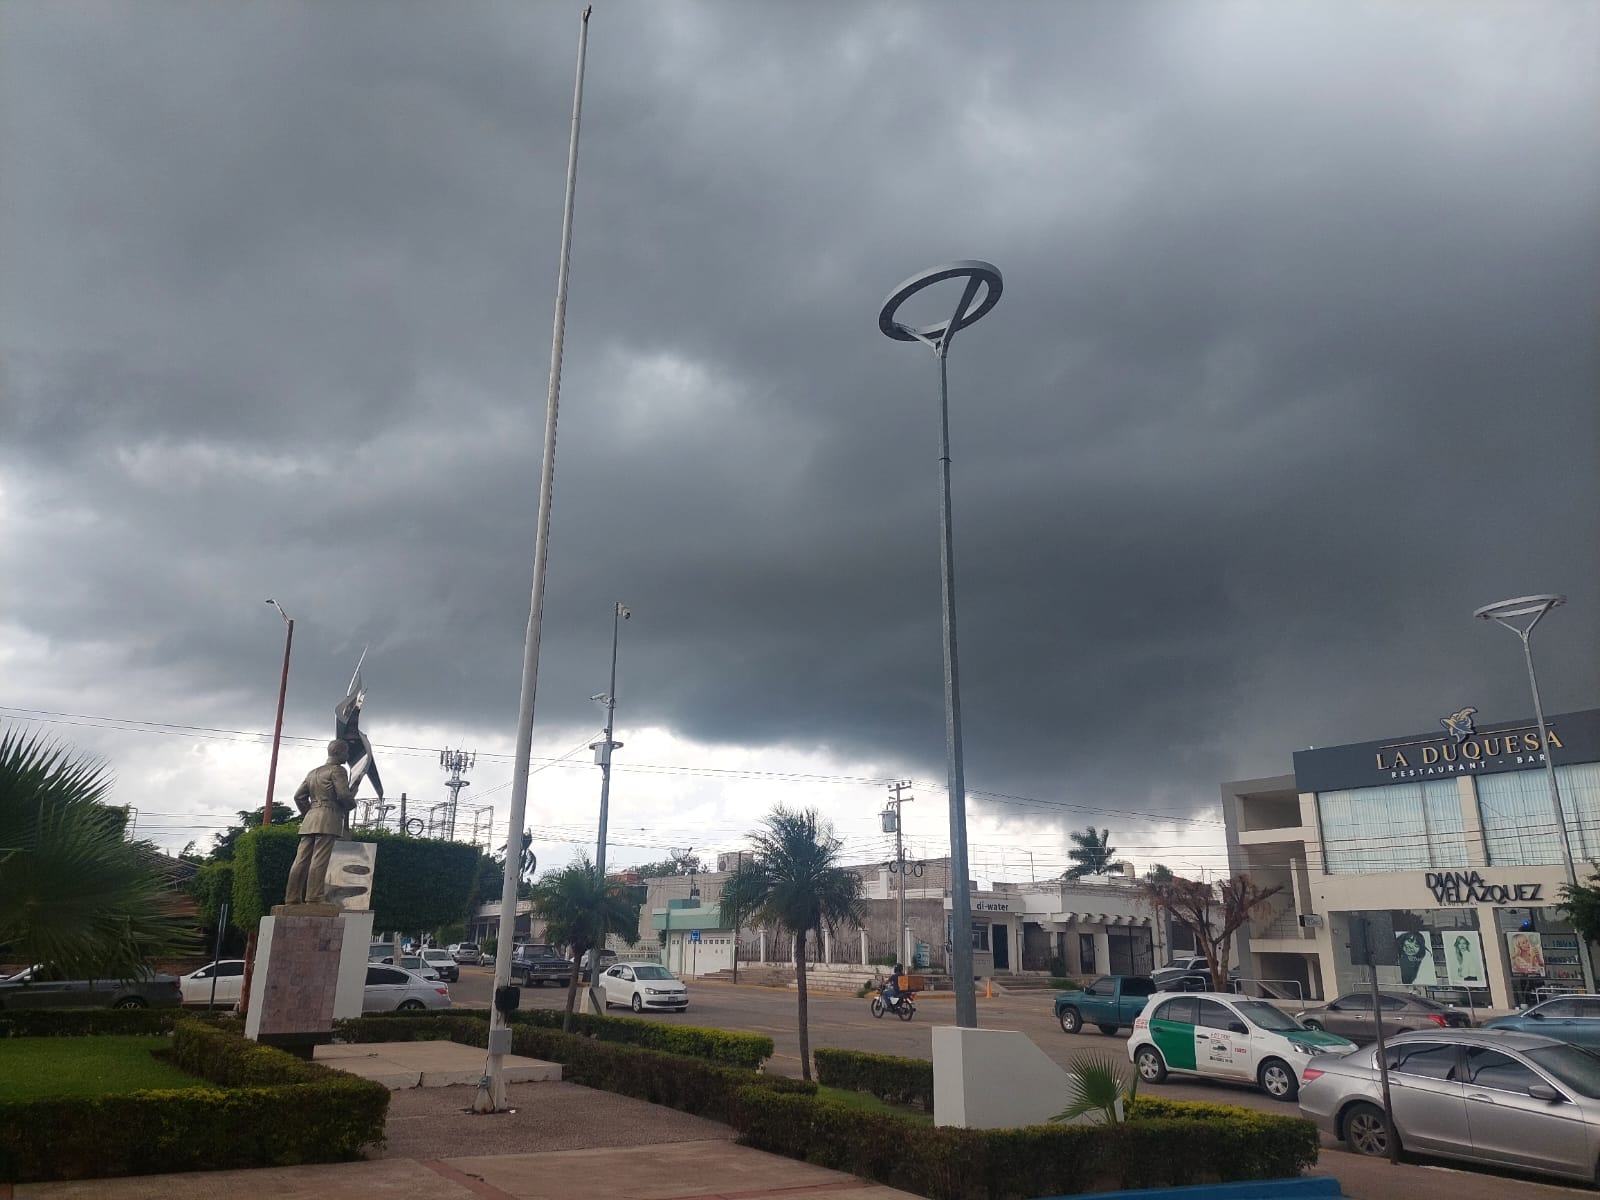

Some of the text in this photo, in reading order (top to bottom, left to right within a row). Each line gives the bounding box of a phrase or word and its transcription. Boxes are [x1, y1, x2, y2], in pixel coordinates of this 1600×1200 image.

[1376, 730, 1563, 770] LA DUQUESA
[1391, 761, 1486, 779] RESTAURANT
[1516, 754, 1546, 764] BAR
[1425, 871, 1482, 888] DIANA
[976, 901, 1008, 911] di-water
